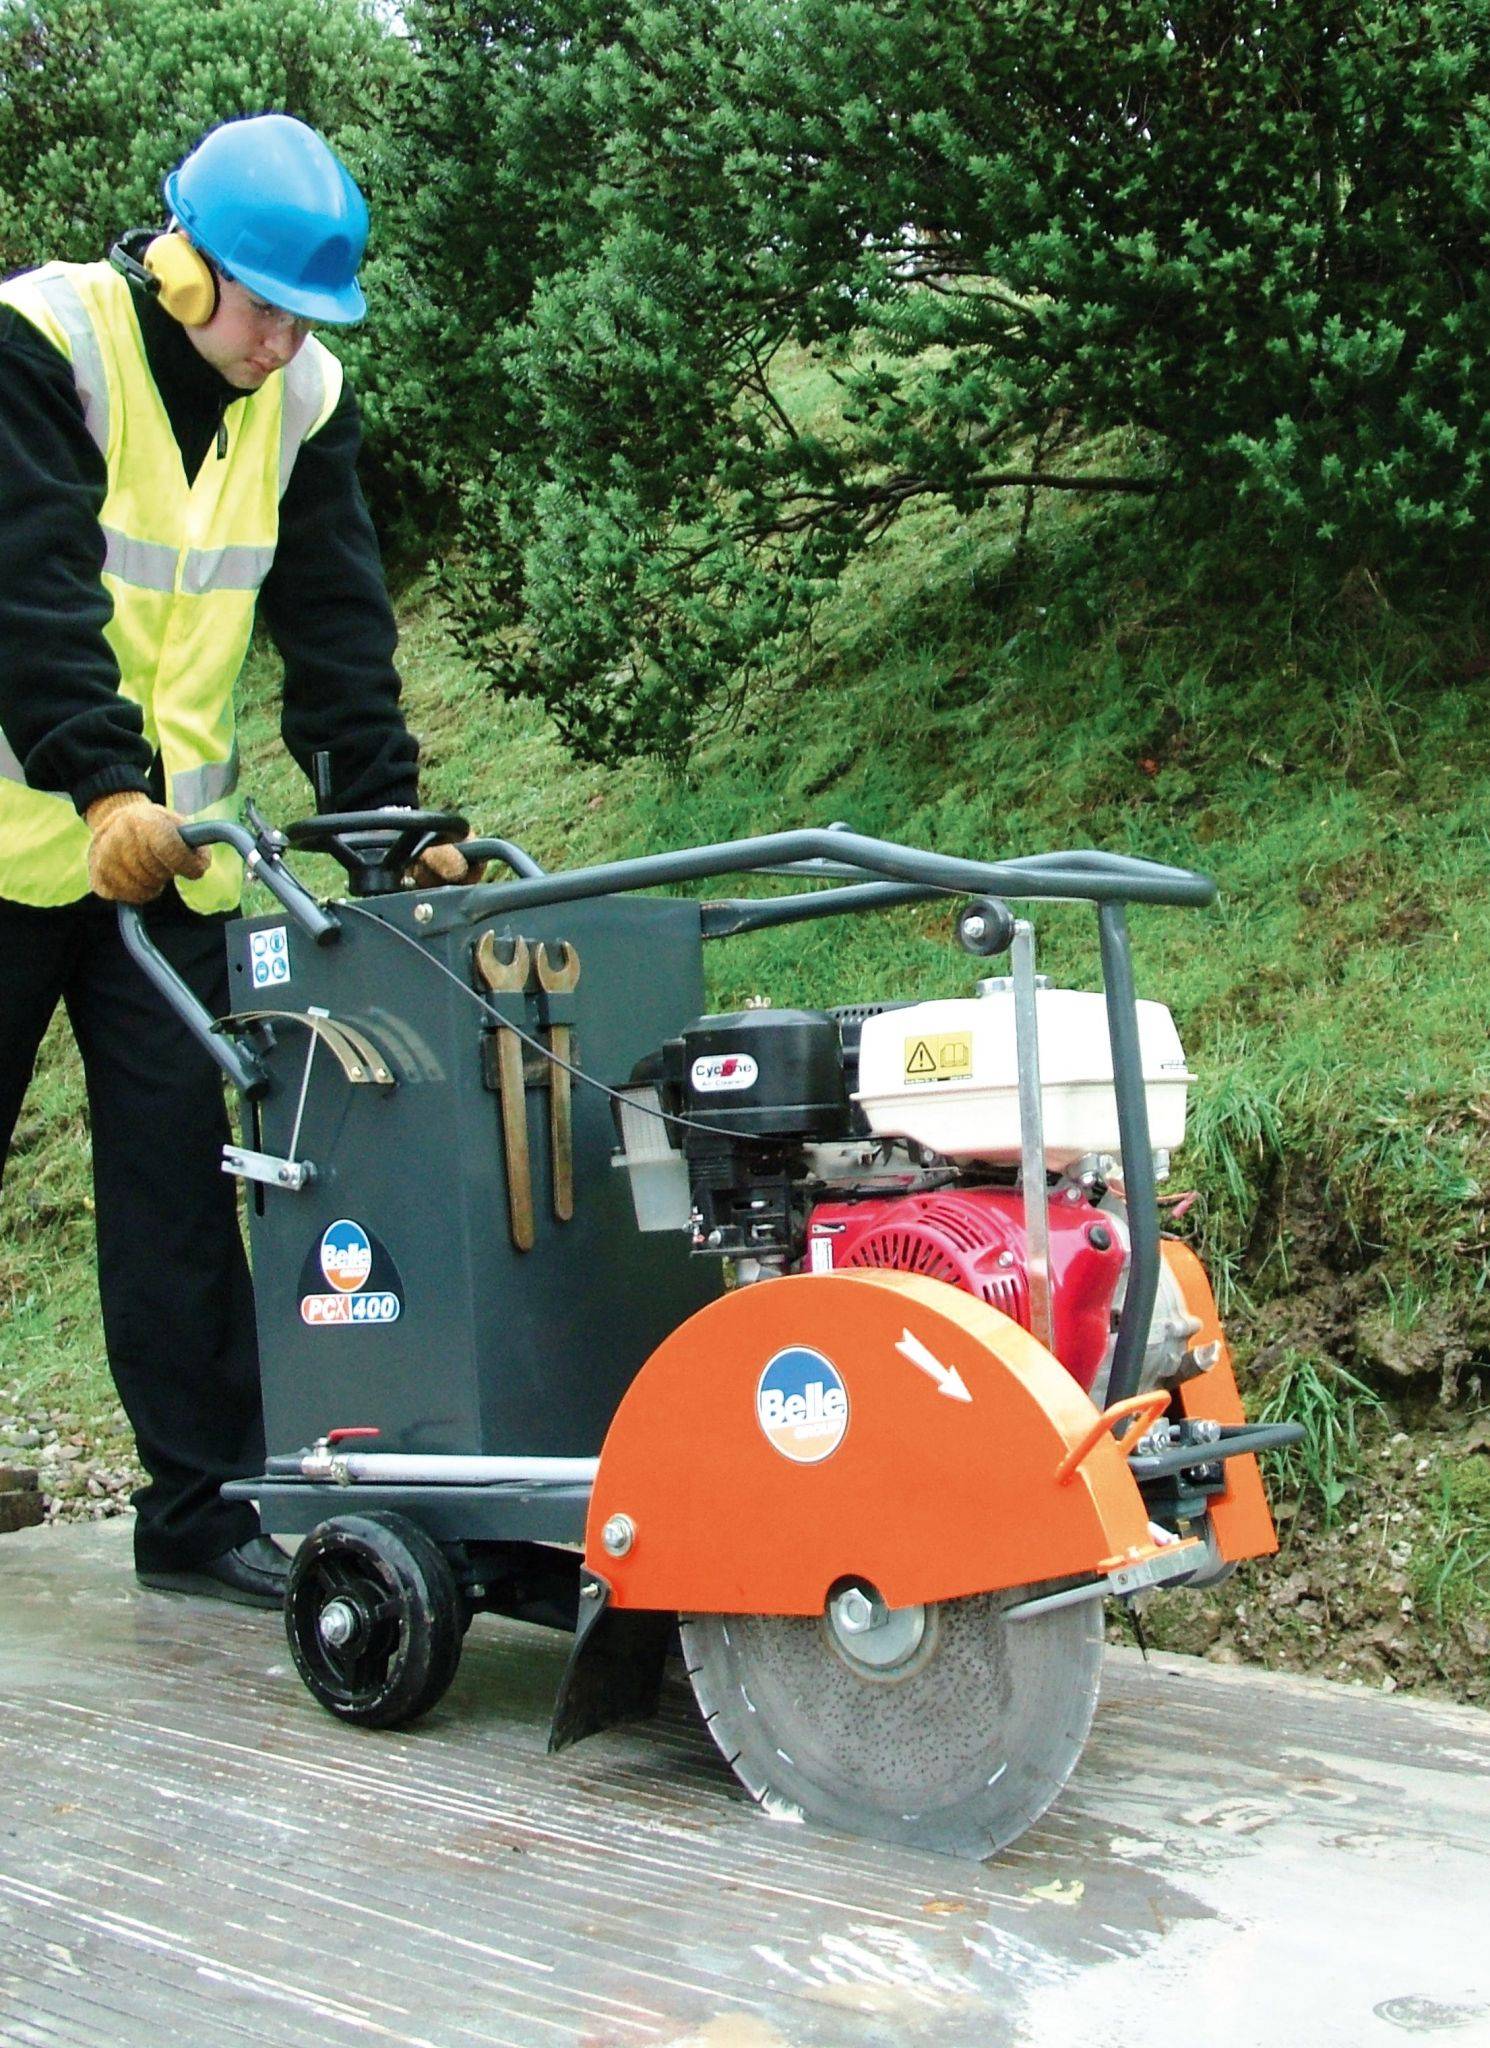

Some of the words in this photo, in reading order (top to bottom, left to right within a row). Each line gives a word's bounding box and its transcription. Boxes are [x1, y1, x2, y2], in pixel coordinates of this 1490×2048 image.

[323, 1244, 370, 1270] Belle
[308, 1298, 350, 1321] PCX
[353, 1296, 395, 1319] 400
[760, 1381, 847, 1429] Belle
